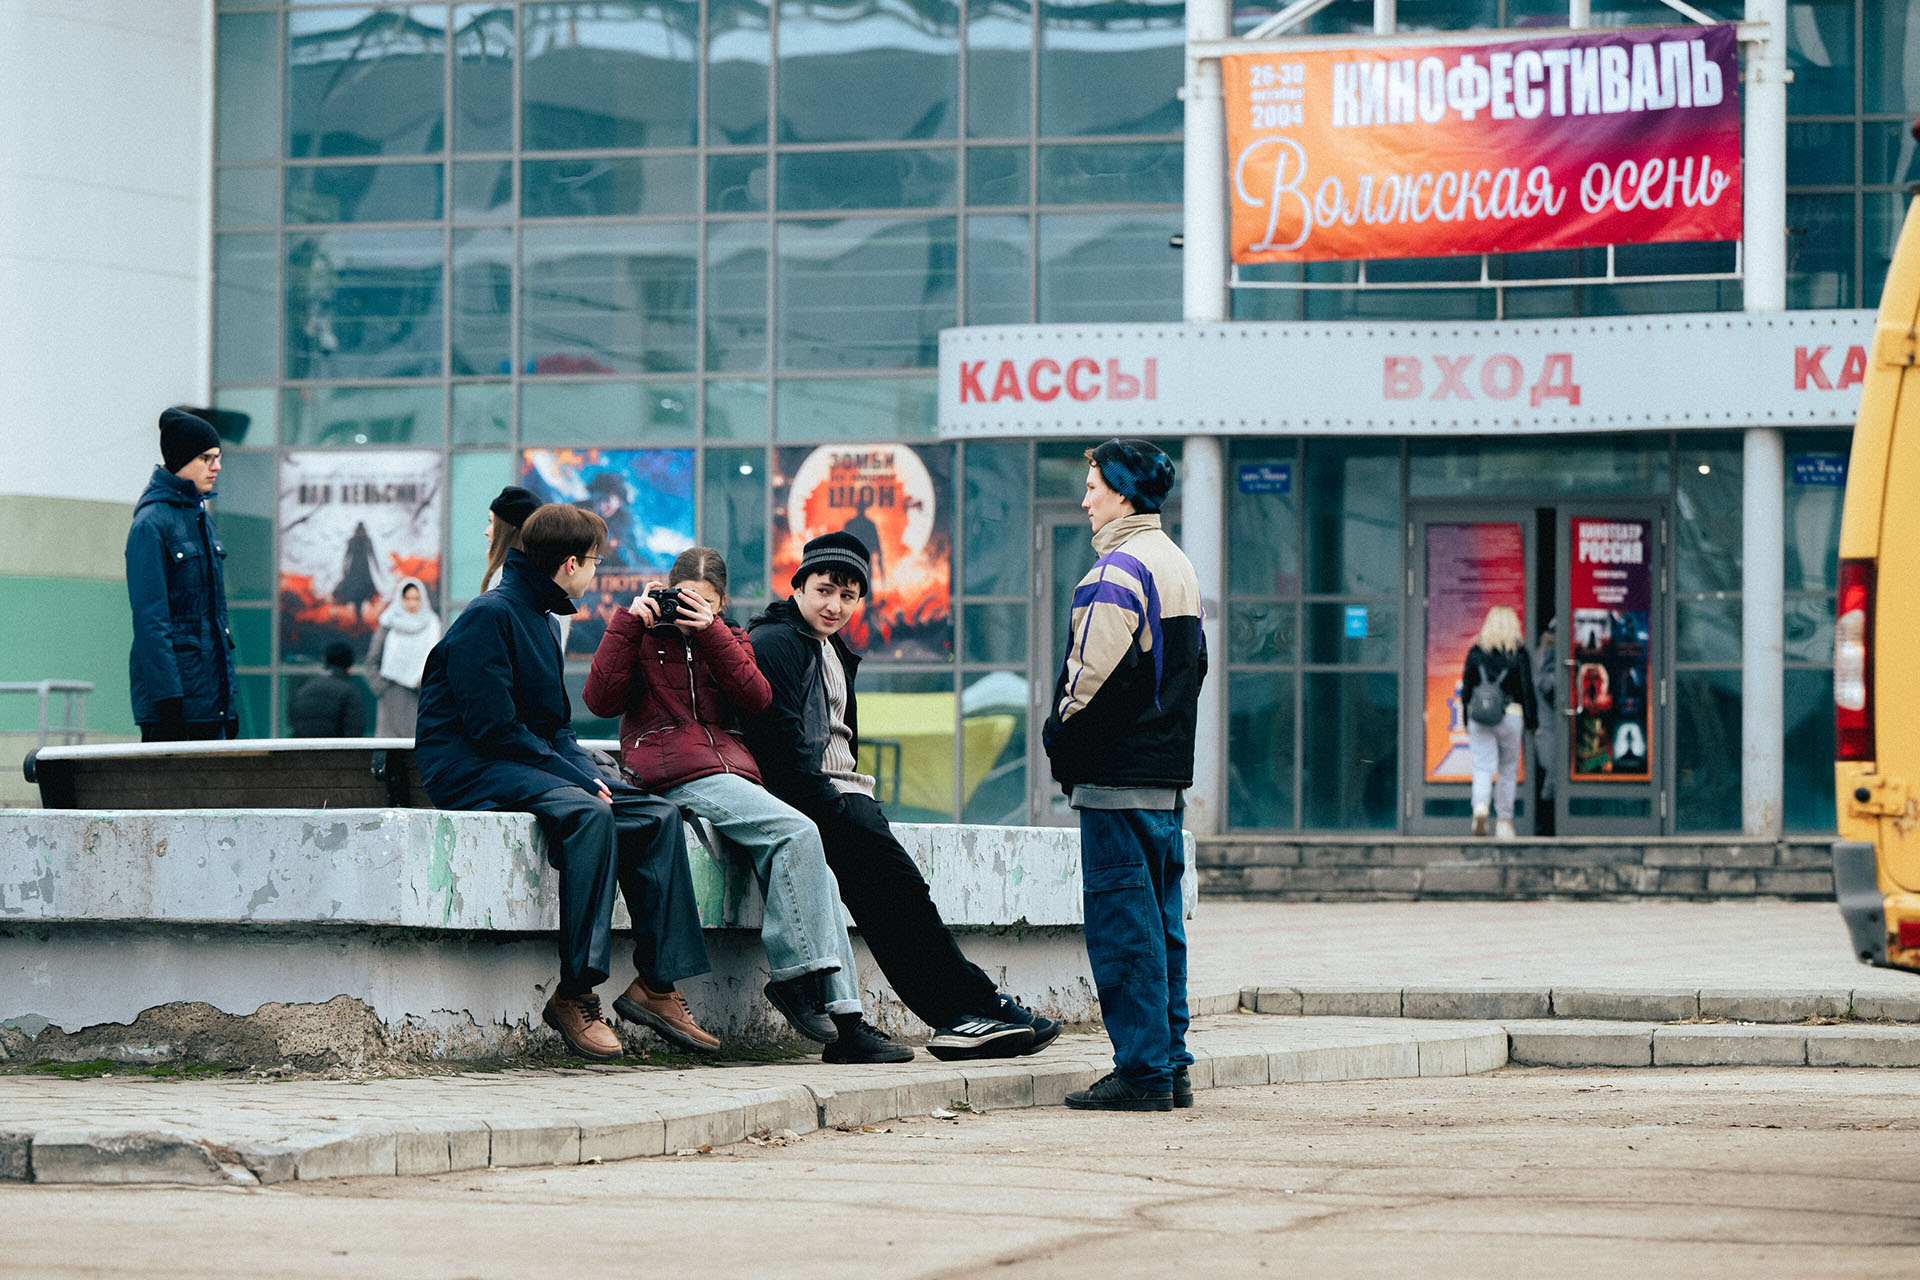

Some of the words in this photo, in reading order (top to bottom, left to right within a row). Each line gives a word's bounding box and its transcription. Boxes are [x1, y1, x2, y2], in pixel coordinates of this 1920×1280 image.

[1331, 39, 1723, 128] КИНОФЕСТИВАЛЬ
[1250, 103, 1304, 129] 2004
[1235, 136, 1566, 252] Волжская
[1580, 155, 1731, 214] осень
[959, 357, 1158, 404] КАССЫ
[1383, 352, 1581, 408] ВХОД
[828, 485, 896, 508] ШОН
